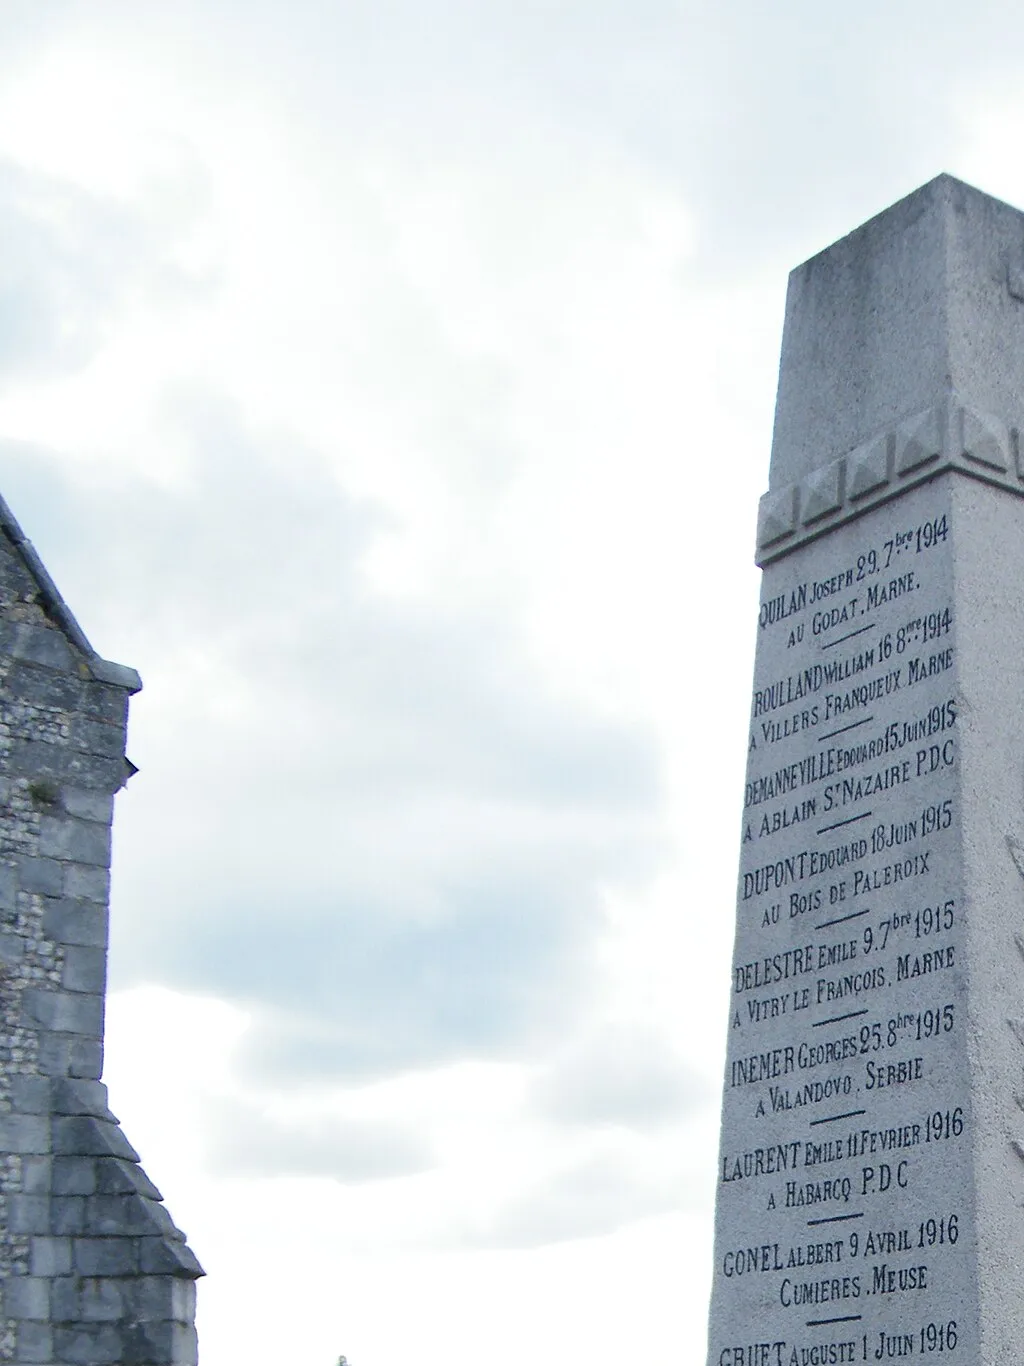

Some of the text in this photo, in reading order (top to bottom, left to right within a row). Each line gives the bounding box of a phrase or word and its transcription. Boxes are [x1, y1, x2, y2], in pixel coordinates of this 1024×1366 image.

[759, 584, 807, 629] QUILAN
[810, 570, 853, 604] JOSEPH
[916, 515, 948, 553] 1914
[754, 664, 822, 717] ROULLAND
[824, 650, 873, 685] WILLIAM
[879, 636, 891, 664] 16
[922, 607, 952, 643] 1914
[787, 624, 804, 648] AU
[749, 648, 953, 751] A VILLERS FRANQUEUX MARNE
[745, 699, 957, 808] DEMANNEVILLE EDOUARD 15 JUIN 1915
[743, 825, 751, 843] A
[759, 799, 816, 837] ABLAIN
[842, 761, 910, 805] NAZAIRE
[742, 800, 952, 900] DUPONT EDOUARD 18 JUIN 1915
[762, 853, 930, 928] AU BOIS DE PALEROIX
[733, 1010, 741, 1028] A
[748, 992, 787, 1023] VITRY
[793, 988, 809, 1011] LE
[897, 946, 955, 982] MARNE
[735, 945, 813, 993] DELESTRE
[819, 939, 857, 969] EMILE
[915, 901, 955, 939] 1915
[731, 1047, 794, 1087] INEMER
[798, 1035, 857, 1068] GEORGES
[916, 1005, 954, 1040] 1915
[755, 1099, 765, 1118] A
[866, 1059, 923, 1090] SERBIE
[722, 1108, 964, 1182] LAURENT EMILE 11 FEVRIER 1916
[767, 1193, 775, 1211] A
[785, 1177, 851, 1208] HABARCQ
[724, 1214, 959, 1278] GONEL ALBERT 9 AVRIL 1916
[780, 1276, 860, 1307] CUMIERES
[862, 1335, 867, 1360] 1
[875, 1331, 914, 1359] JUIN
[920, 1321, 958, 1353] 1916
